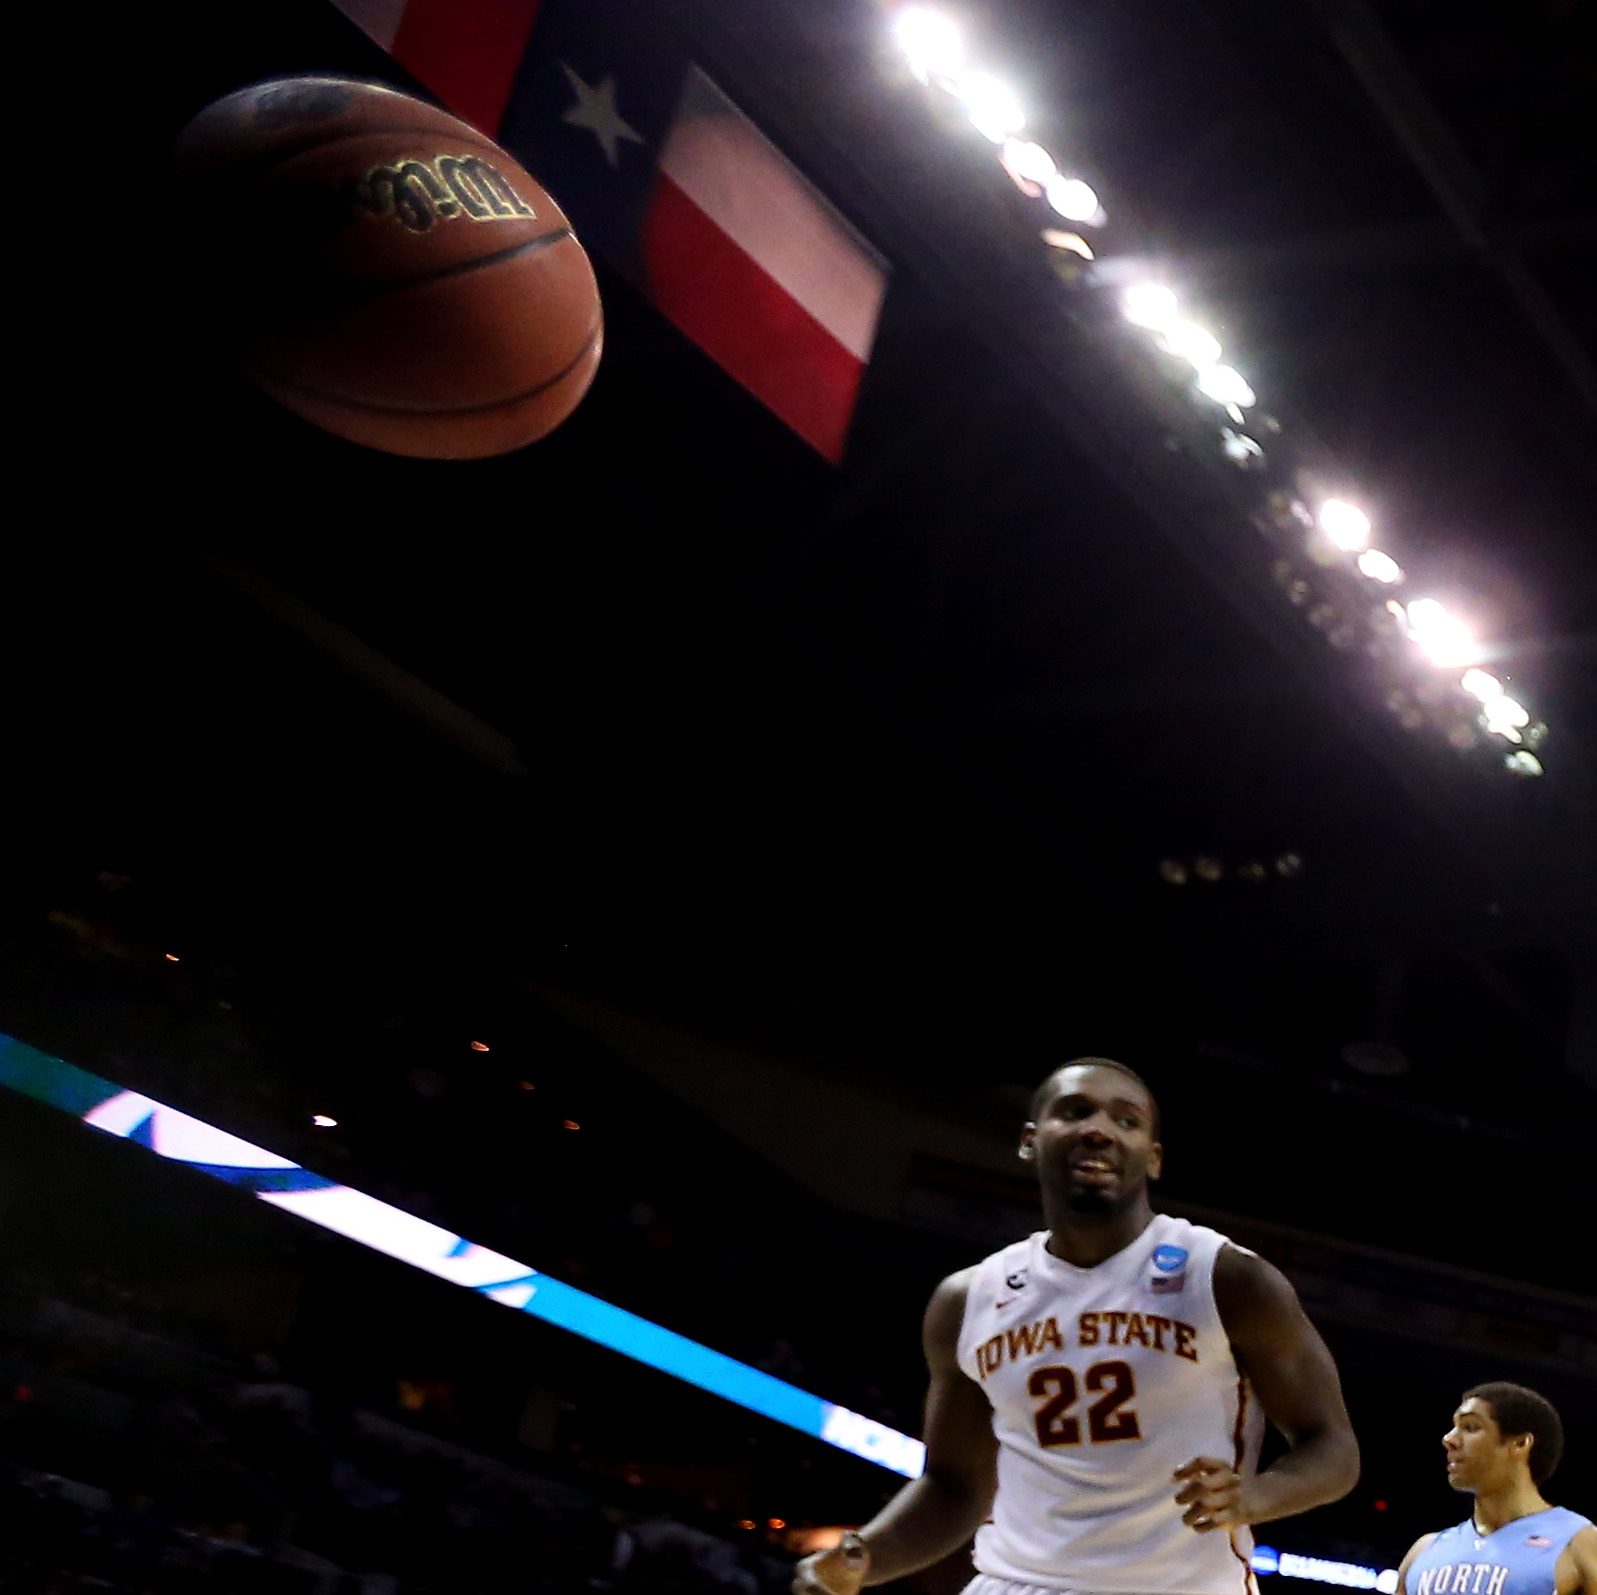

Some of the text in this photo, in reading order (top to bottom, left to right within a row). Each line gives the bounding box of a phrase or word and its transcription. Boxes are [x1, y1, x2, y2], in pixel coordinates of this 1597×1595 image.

[976, 1310, 1199, 1381] IOWA STATE
[1027, 1360, 1143, 1448] 22
